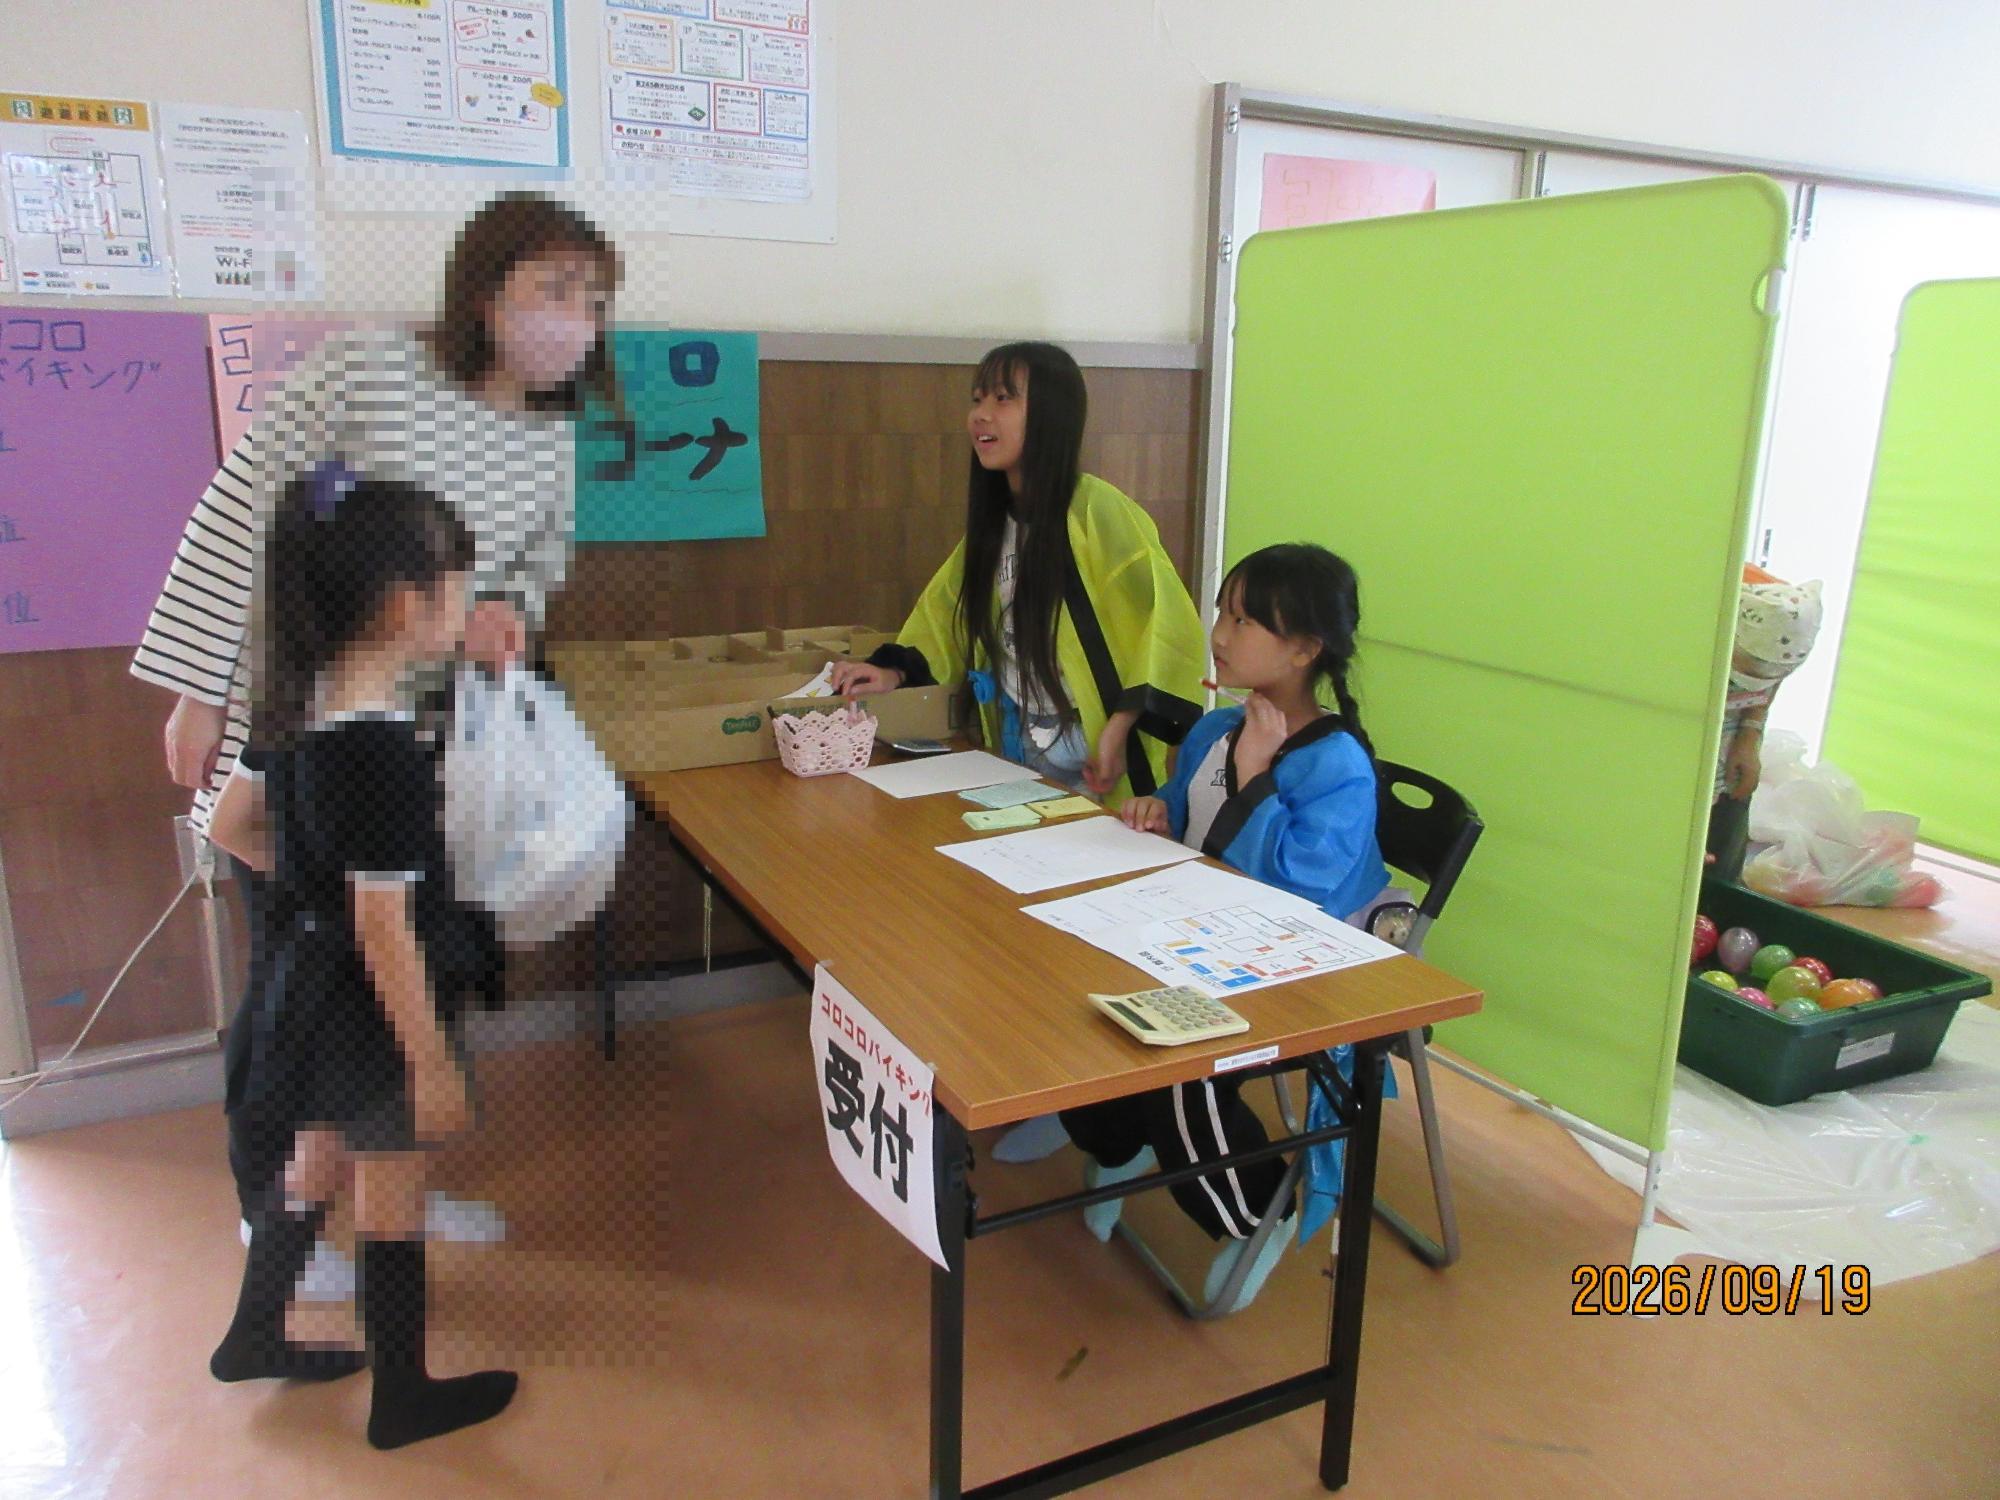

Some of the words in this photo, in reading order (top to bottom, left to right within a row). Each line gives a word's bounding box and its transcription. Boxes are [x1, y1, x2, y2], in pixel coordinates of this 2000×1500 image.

[216, 256, 251, 268] Wi-F
[0, 319, 87, 352] コロ
[825, 1037, 914, 1204] 受付
